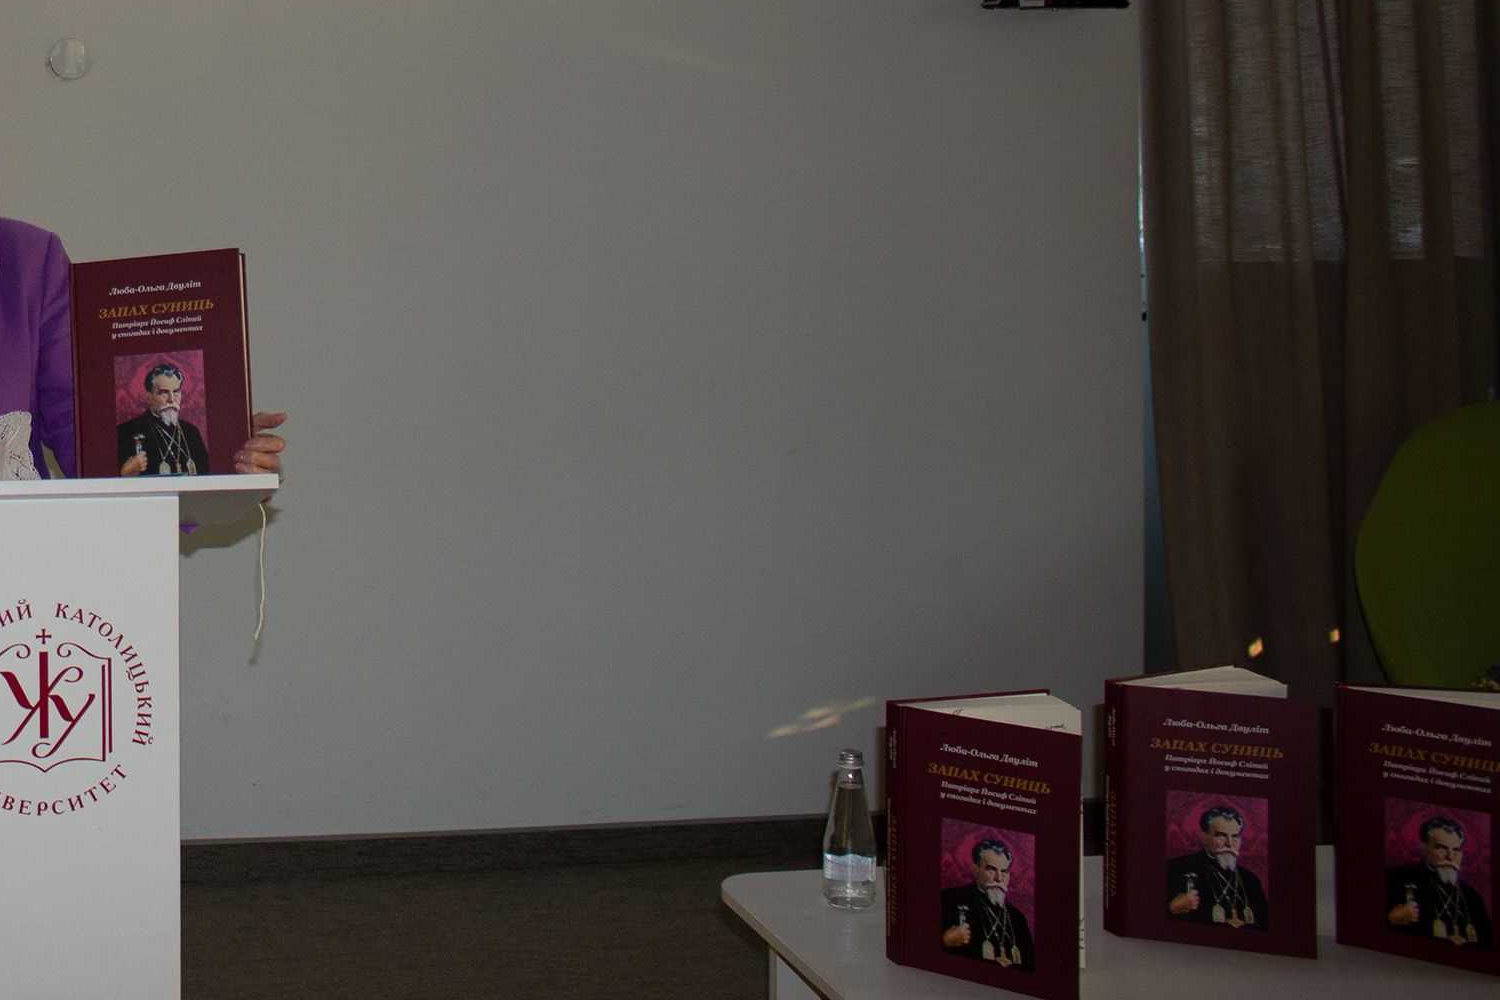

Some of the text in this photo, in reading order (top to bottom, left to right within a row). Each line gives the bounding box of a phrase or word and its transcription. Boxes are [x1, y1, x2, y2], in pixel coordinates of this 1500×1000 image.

[109, 280, 201, 296] Люба-Ольга Двуліт
[98, 299, 215, 319] ЗАПАХ СУНИЦЬ
[54, 602, 154, 746] КАТОЛИЦЬКИЙ
[1163, 718, 1228, 731] Люба-Ольга
[940, 743, 999, 761] Люба-Ольга
[1150, 737, 1284, 760] ЗАПАХ СУНИЦЬ
[1368, 742, 1426, 761] ЗАПАХ
[927, 762, 1051, 795] ЗАПАХ СУНИЦЬ
